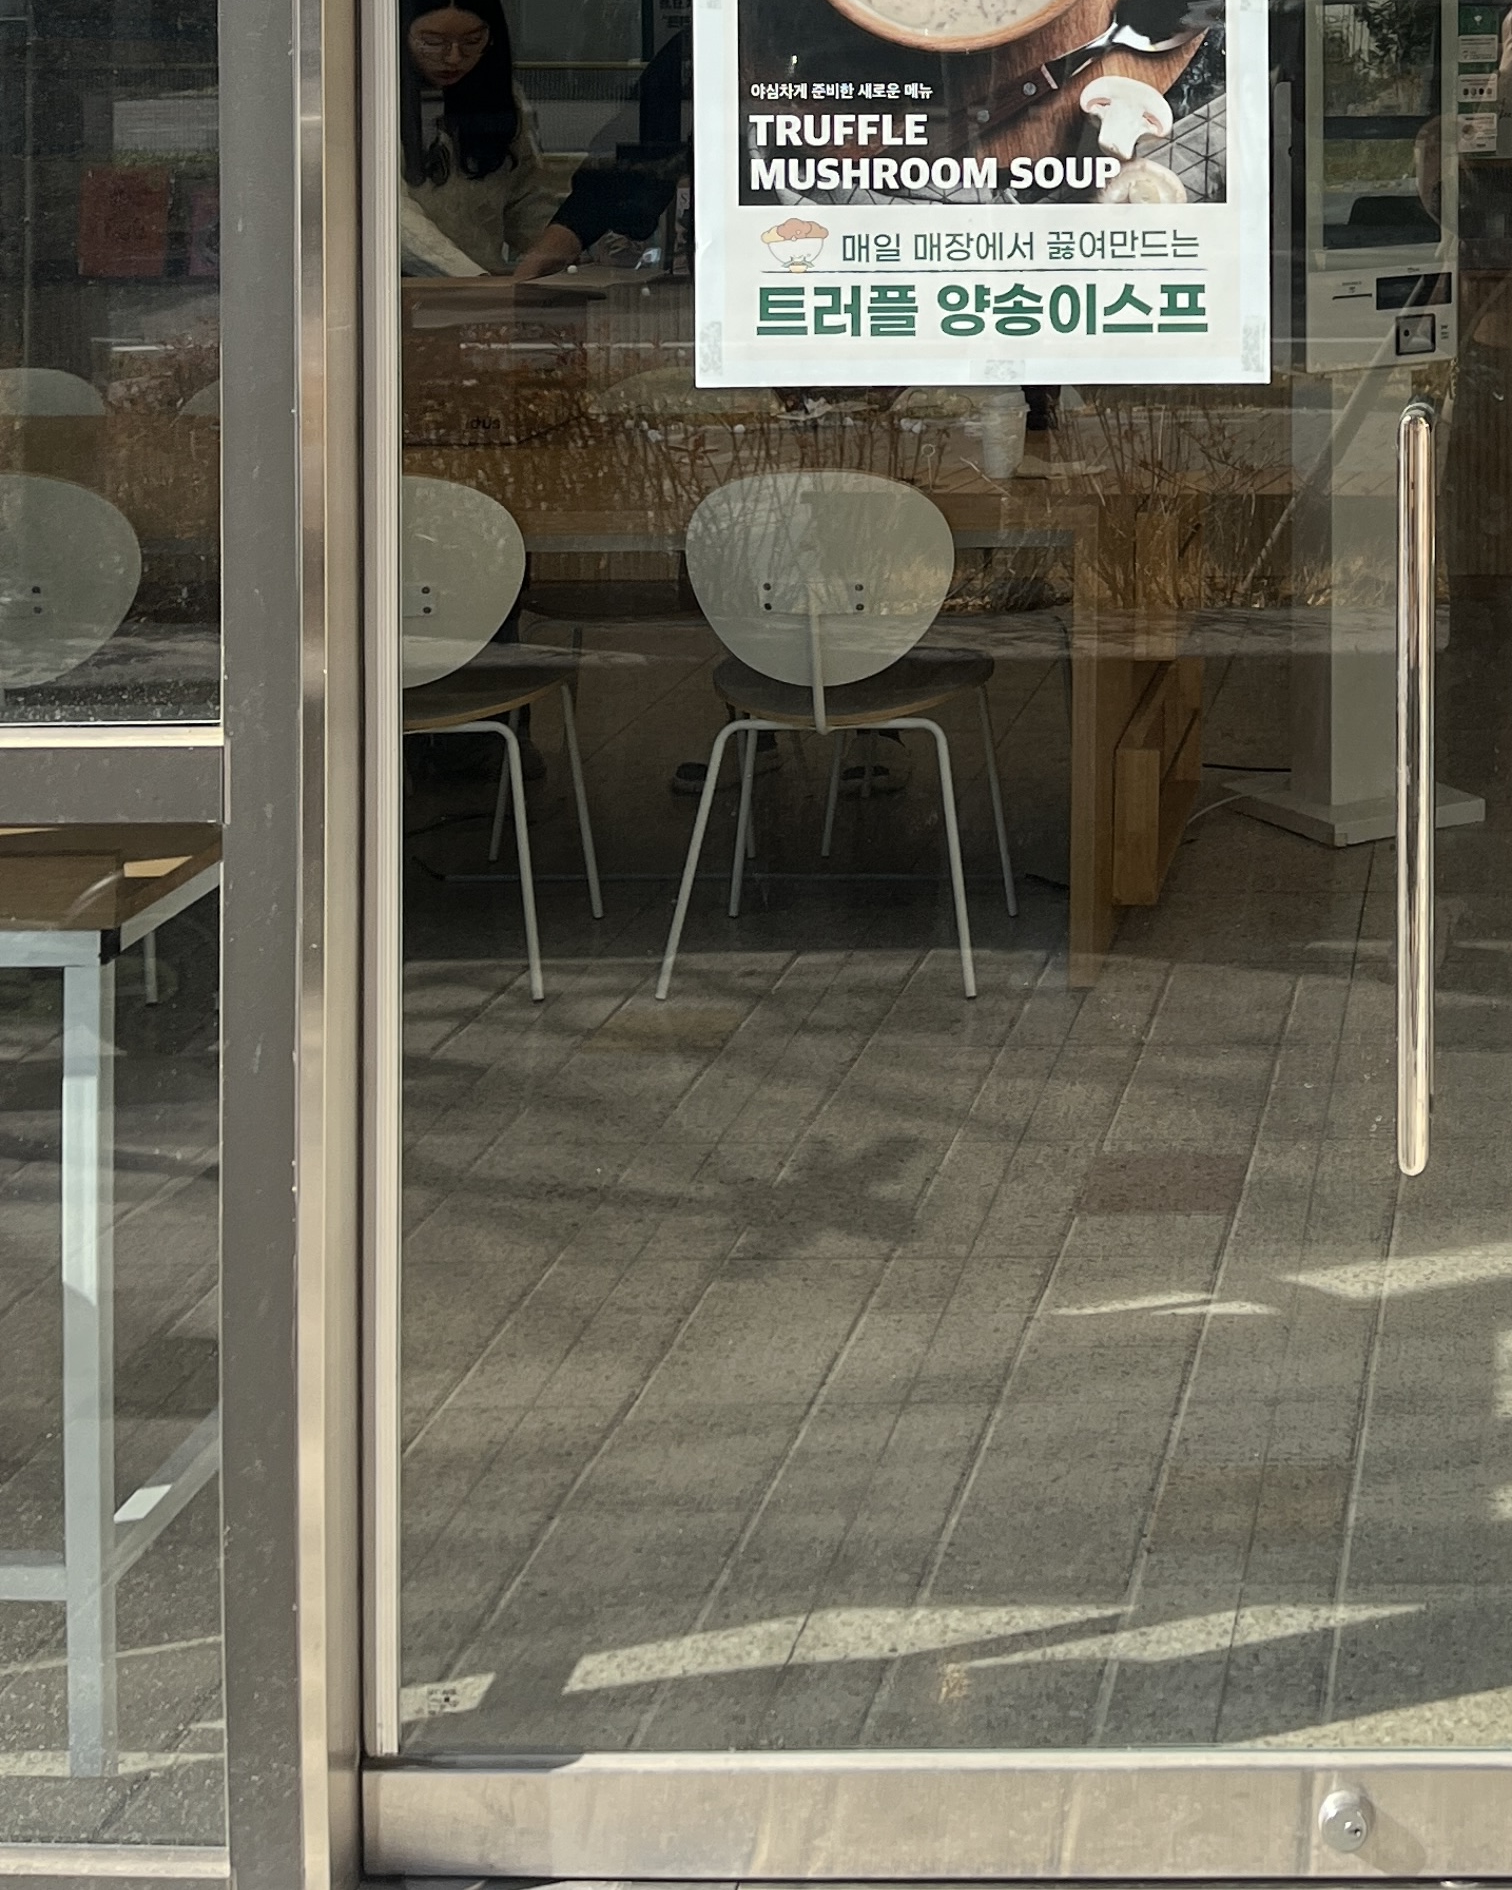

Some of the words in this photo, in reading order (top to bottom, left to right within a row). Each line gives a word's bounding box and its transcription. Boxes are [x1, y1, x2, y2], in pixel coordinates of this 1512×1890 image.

[750, 82, 807, 100] 야심차게
[810, 82, 854, 100] 준비한
[858, 82, 901, 100] 새로운
[904, 82, 934, 100] 메뉴
[749, 113, 929, 147] TRUFFLE
[750, 156, 998, 191] MUSHROOM
[1009, 156, 1121, 190] SOUP
[841, 232, 902, 263] 매일
[914, 230, 1036, 262] 매장에서
[1046, 228, 1201, 261] 끓여만드는
[756, 283, 919, 338] 트러플
[937, 282, 1209, 337] 양송이스프
